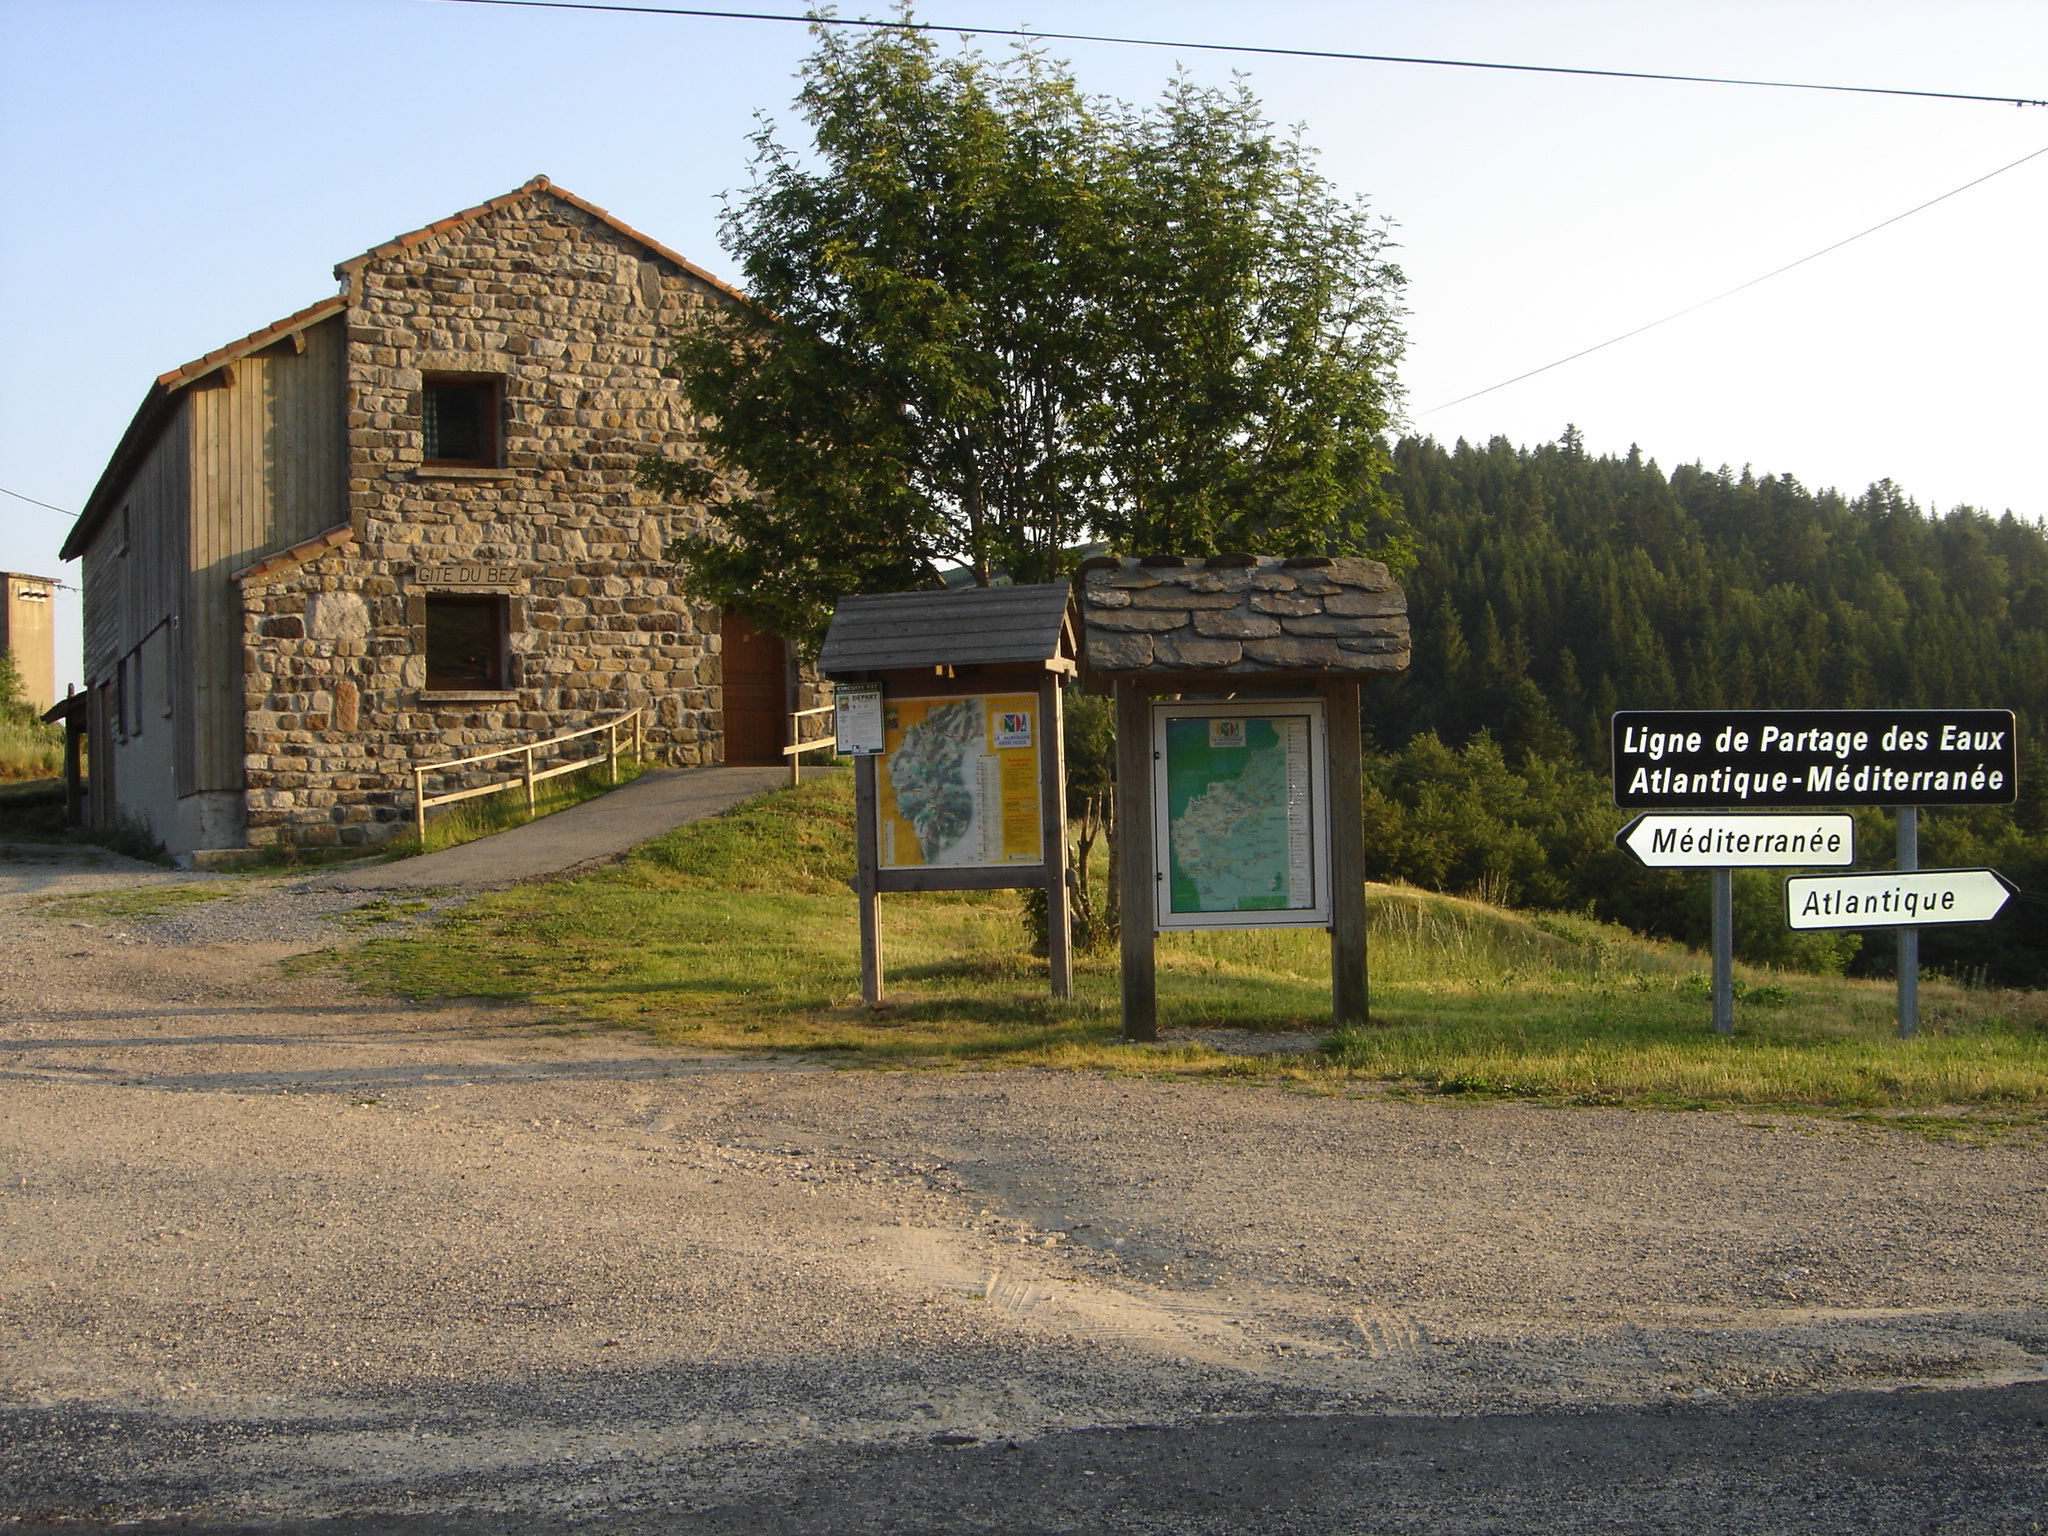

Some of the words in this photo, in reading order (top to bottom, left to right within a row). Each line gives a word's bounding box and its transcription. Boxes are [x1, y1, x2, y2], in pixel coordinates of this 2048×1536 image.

[418, 567, 453, 583] GITE
[460, 567, 481, 583] DU
[487, 567, 519, 583] BEZ
[1623, 726, 1702, 761] Ligne
[1715, 725, 1749, 753] de
[1760, 725, 1869, 759] Partage
[1882, 725, 1929, 752] des
[1940, 724, 2005, 752] Eaux
[1651, 826, 1842, 855] Méditerranée
[1802, 886, 1956, 918] Atlantique
